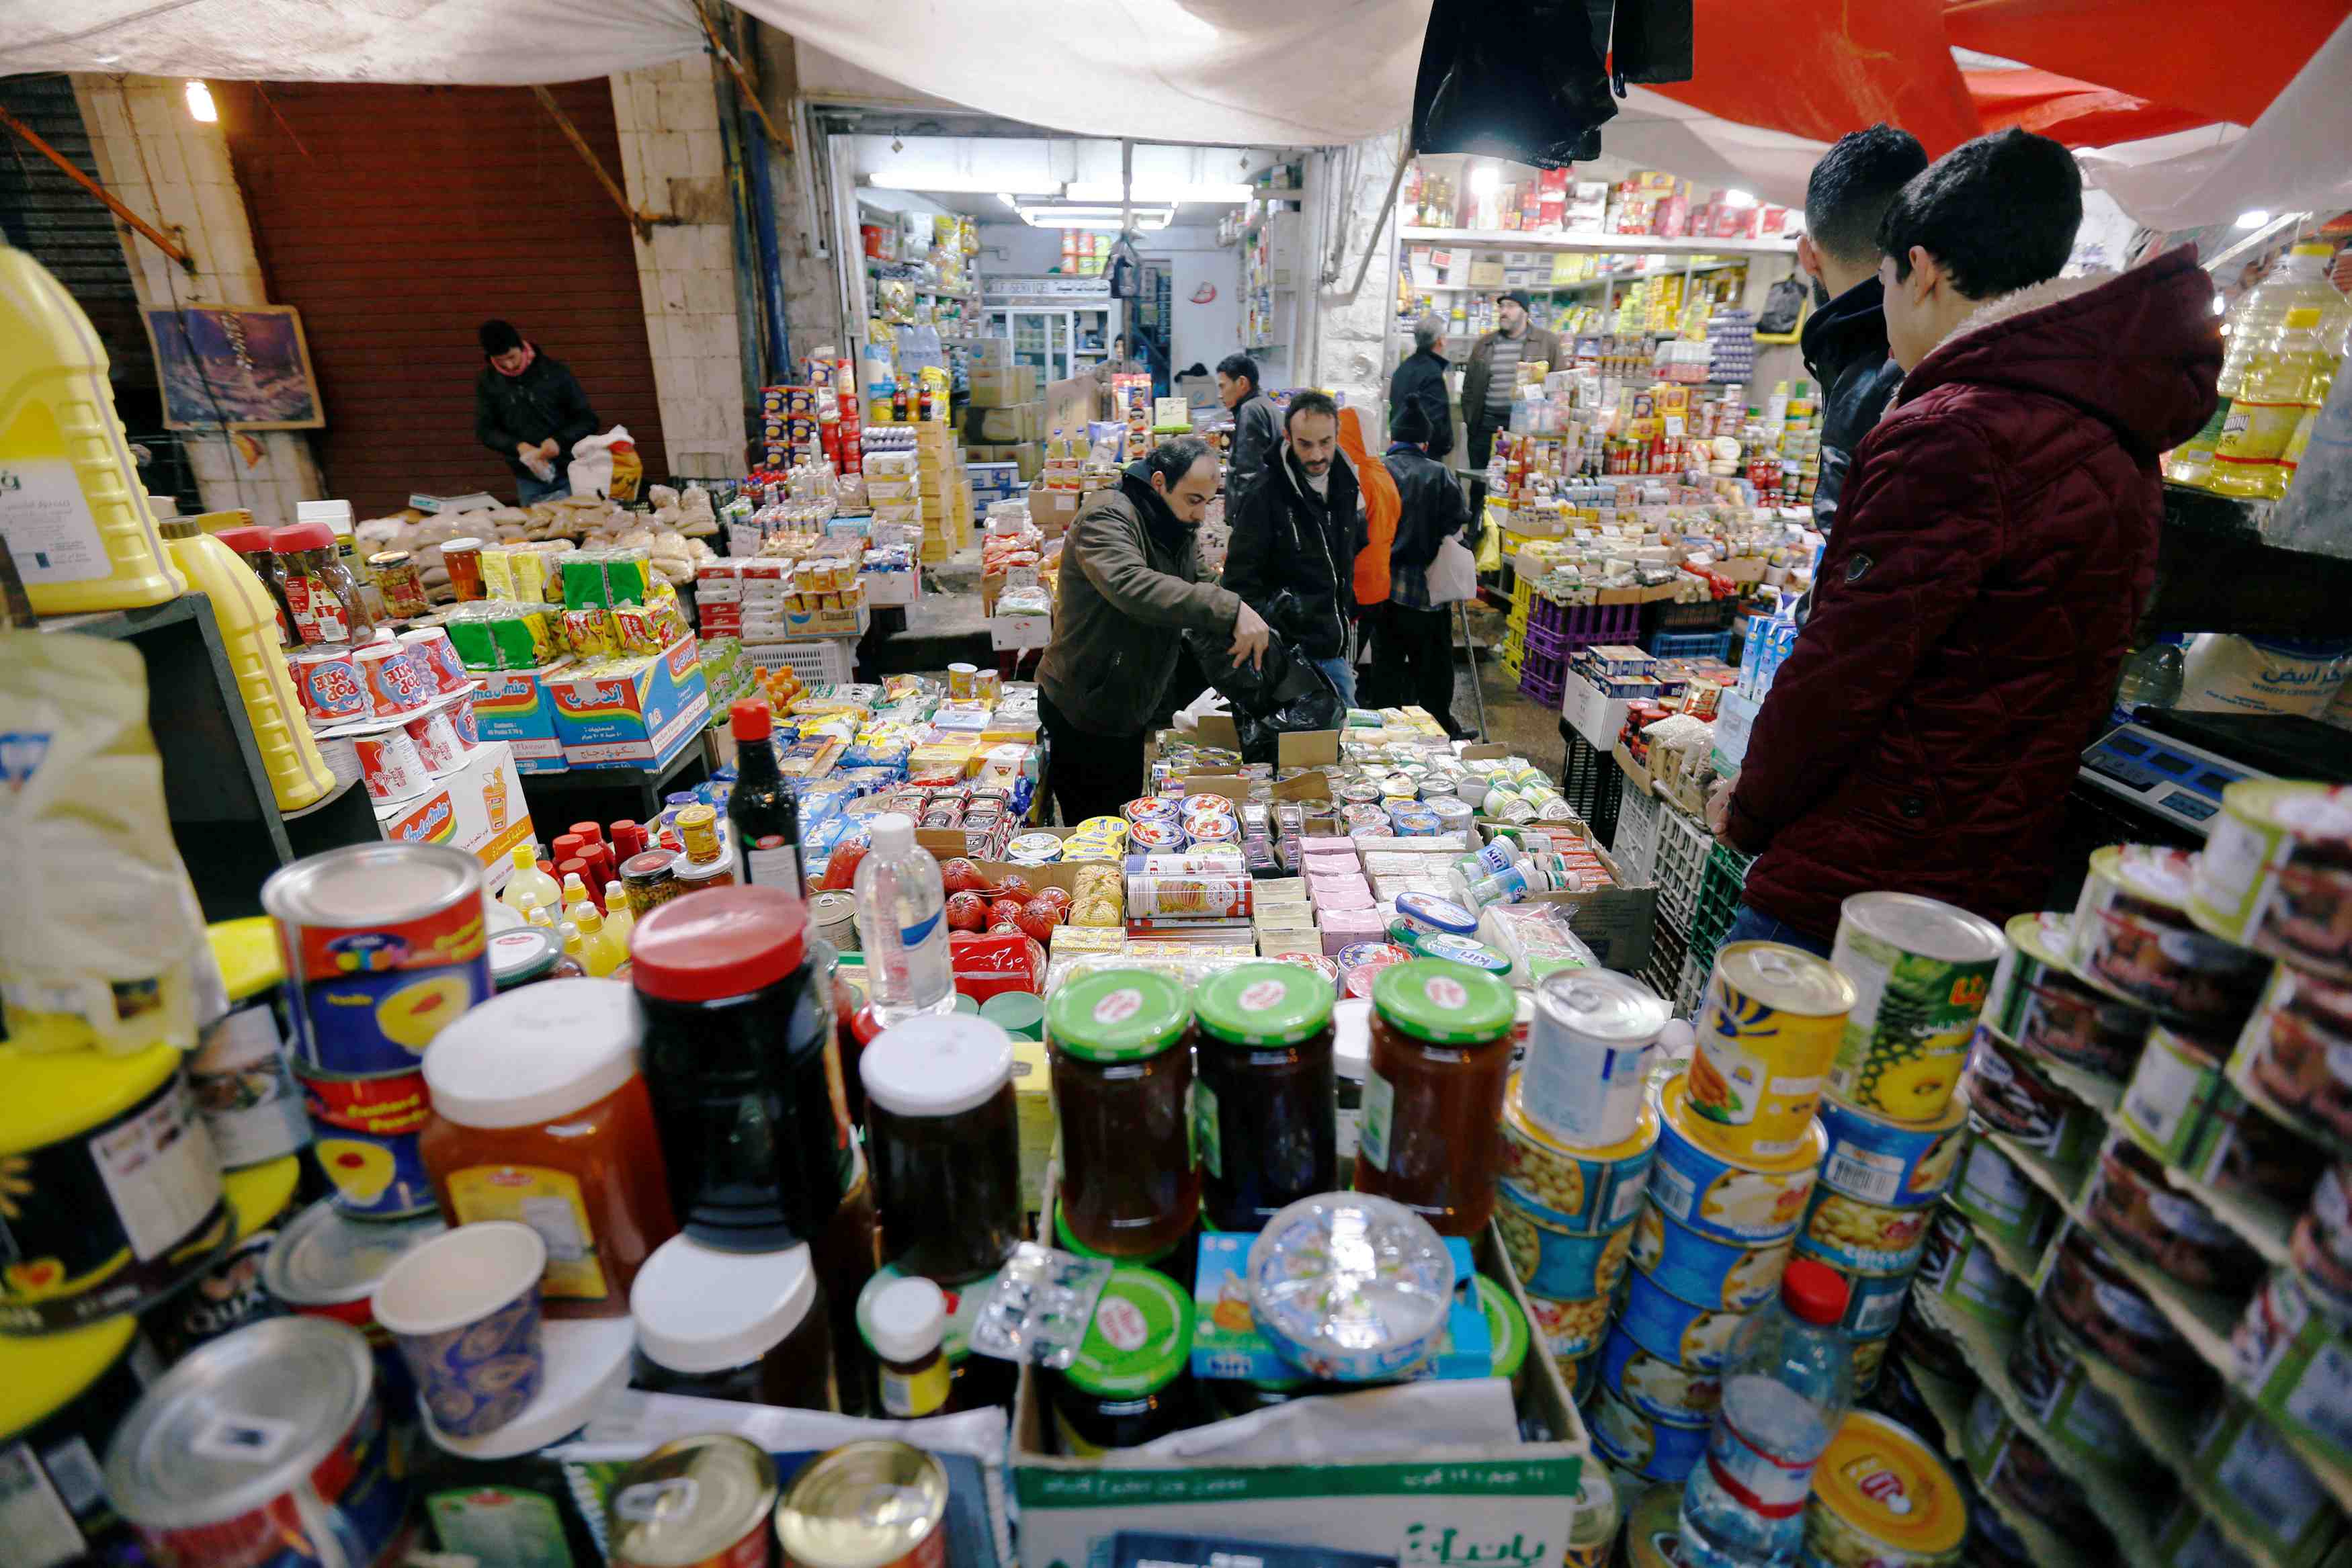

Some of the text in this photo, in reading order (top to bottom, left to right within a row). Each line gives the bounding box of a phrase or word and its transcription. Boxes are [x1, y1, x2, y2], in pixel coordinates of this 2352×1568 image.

[312, 667, 349, 692] MIE
[382, 661, 415, 686] MIE
[327, 680, 360, 702] POP
[403, 801, 448, 842] Indomie
[1486, 847, 1507, 869] kiri
[1458, 949, 1491, 967] kiri
